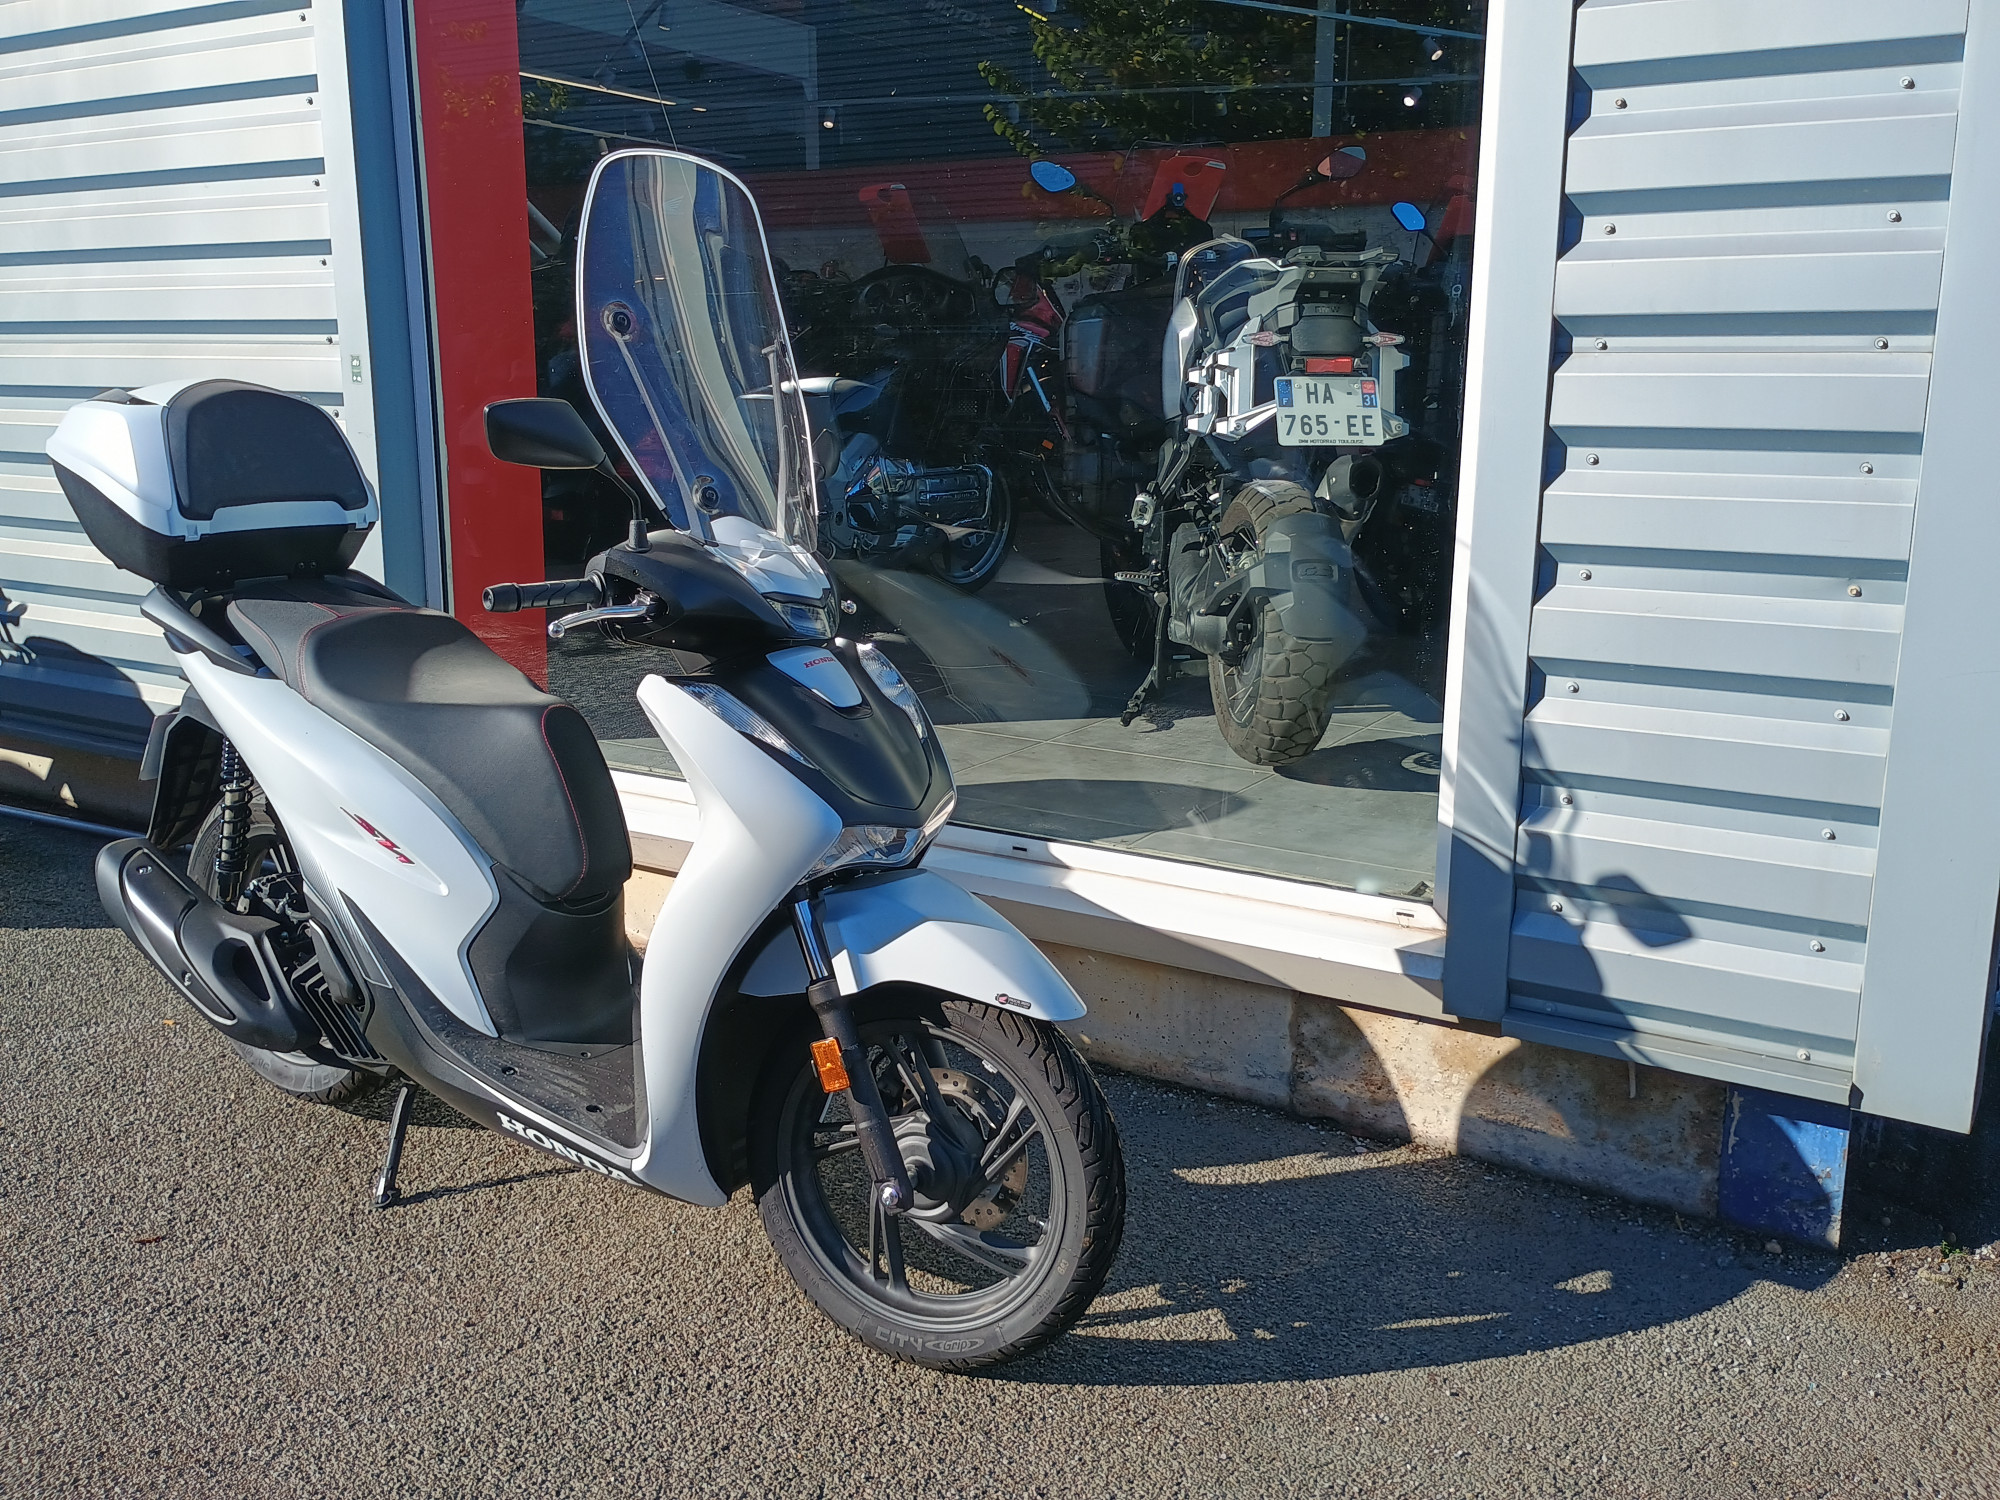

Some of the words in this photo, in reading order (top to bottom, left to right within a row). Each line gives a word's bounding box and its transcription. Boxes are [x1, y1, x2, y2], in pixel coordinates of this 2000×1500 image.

[1363, 393, 1377, 406] 31
[496, 1111, 644, 1187] HONDA
[875, 1325, 923, 1352] CITY
